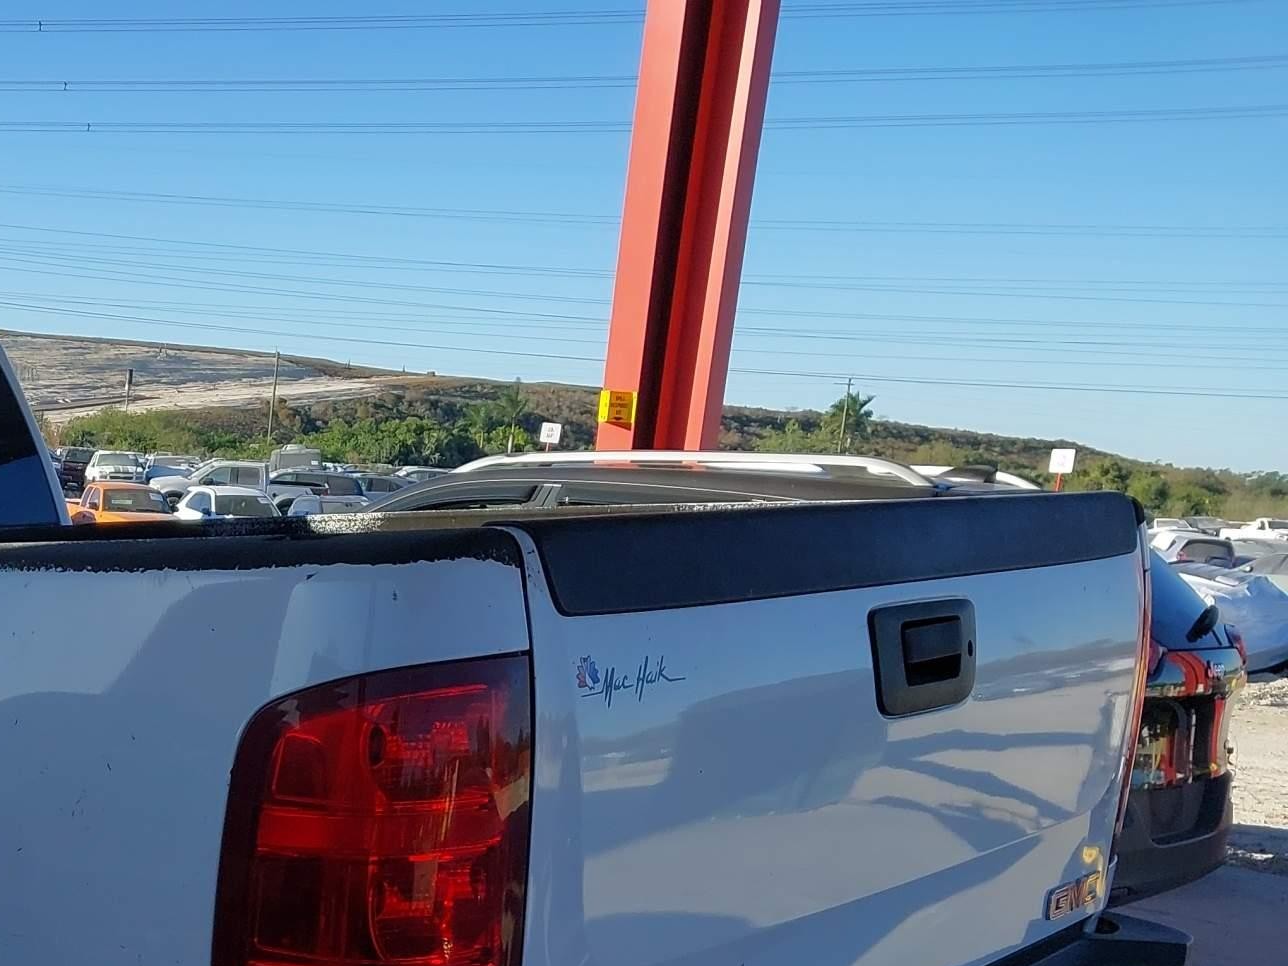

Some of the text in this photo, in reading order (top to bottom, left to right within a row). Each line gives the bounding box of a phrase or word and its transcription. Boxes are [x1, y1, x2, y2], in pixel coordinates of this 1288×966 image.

[581, 655, 686, 708] Mac Haik
[1049, 871, 1101, 920] GMC
